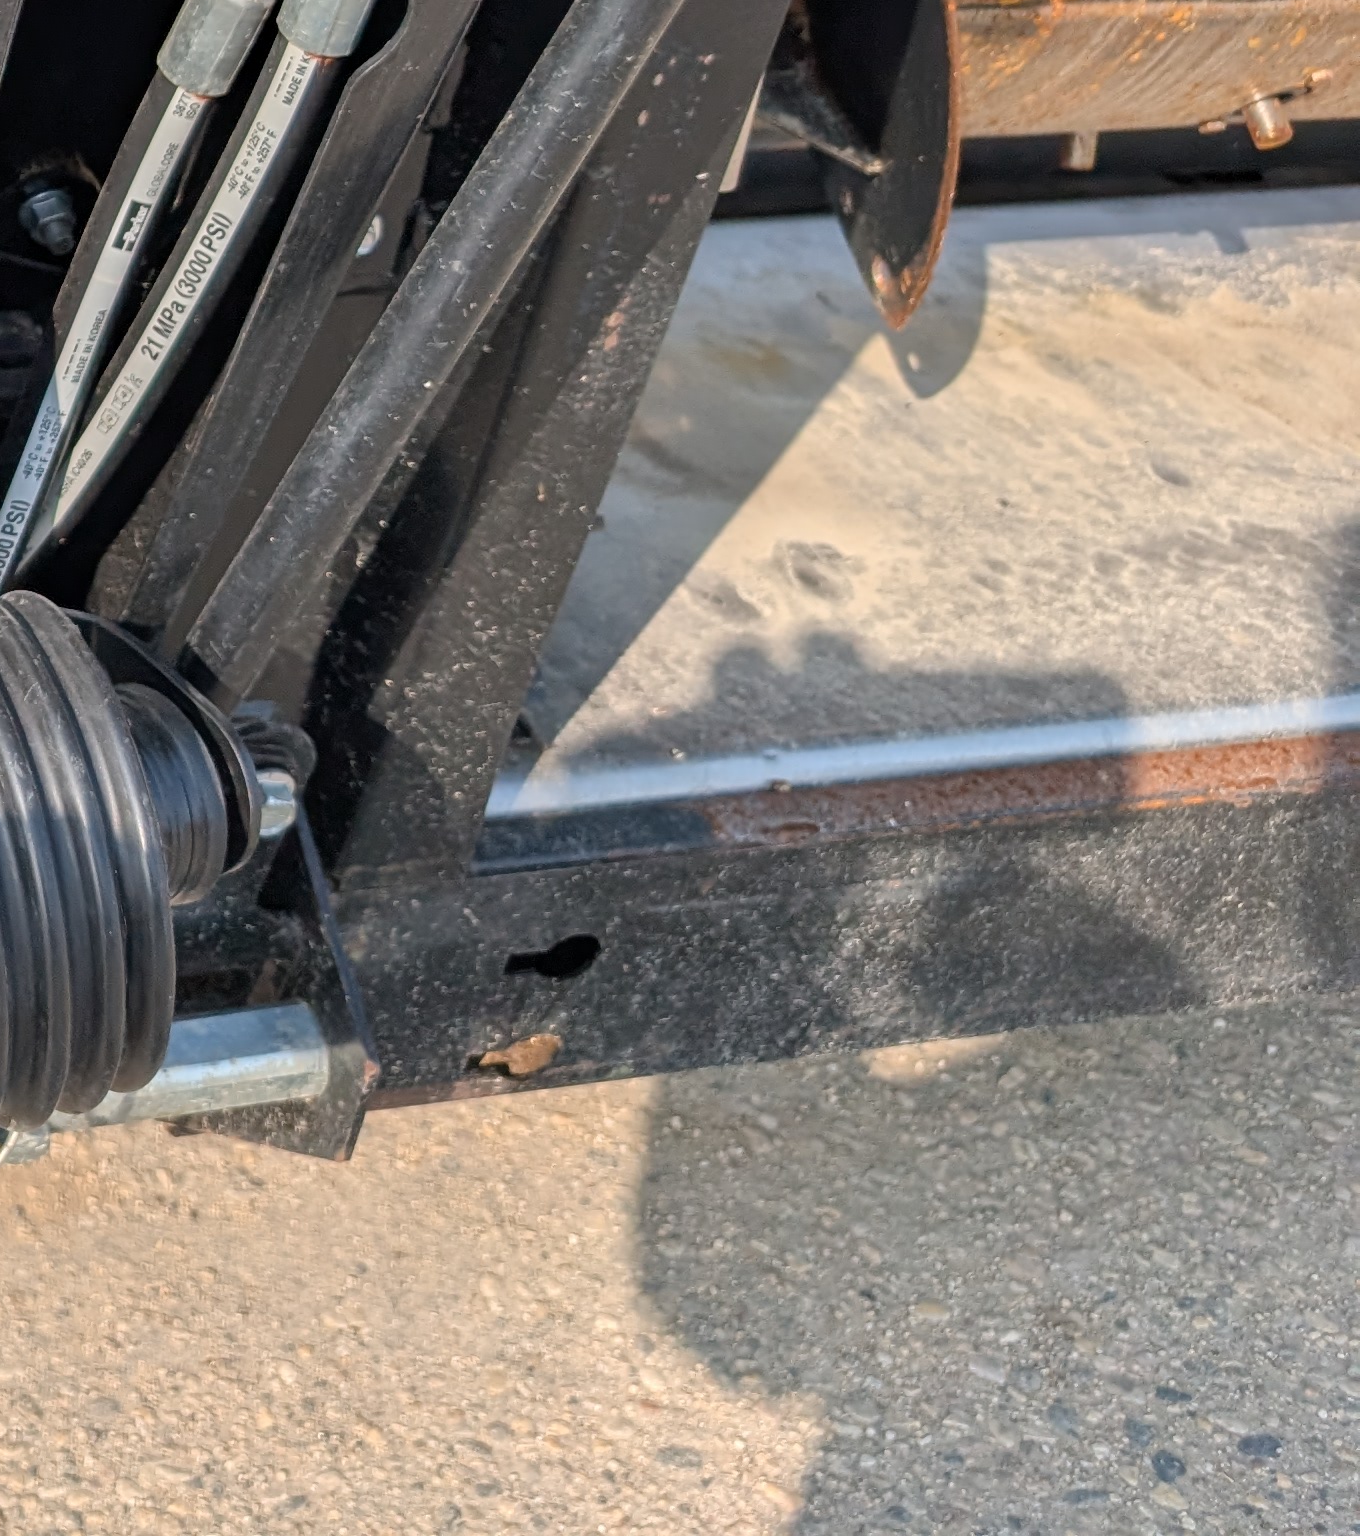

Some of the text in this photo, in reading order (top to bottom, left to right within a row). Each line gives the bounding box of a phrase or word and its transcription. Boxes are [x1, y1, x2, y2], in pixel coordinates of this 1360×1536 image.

[282, 76, 302, 106] MADE
[295, 64, 307, 76] IN
[184, 102, 201, 121] ISO
[246, 131, 260, 157] +125°
[256, 137, 272, 163] +257°
[146, 142, 180, 197] GLOBALCORE
[141, 212, 233, 361] 21 MPa (3000 PSI)
[71, 356, 92, 384] MADE
[87, 309, 111, 342] KOREA
[0, 500, 33, 536] PSI)
